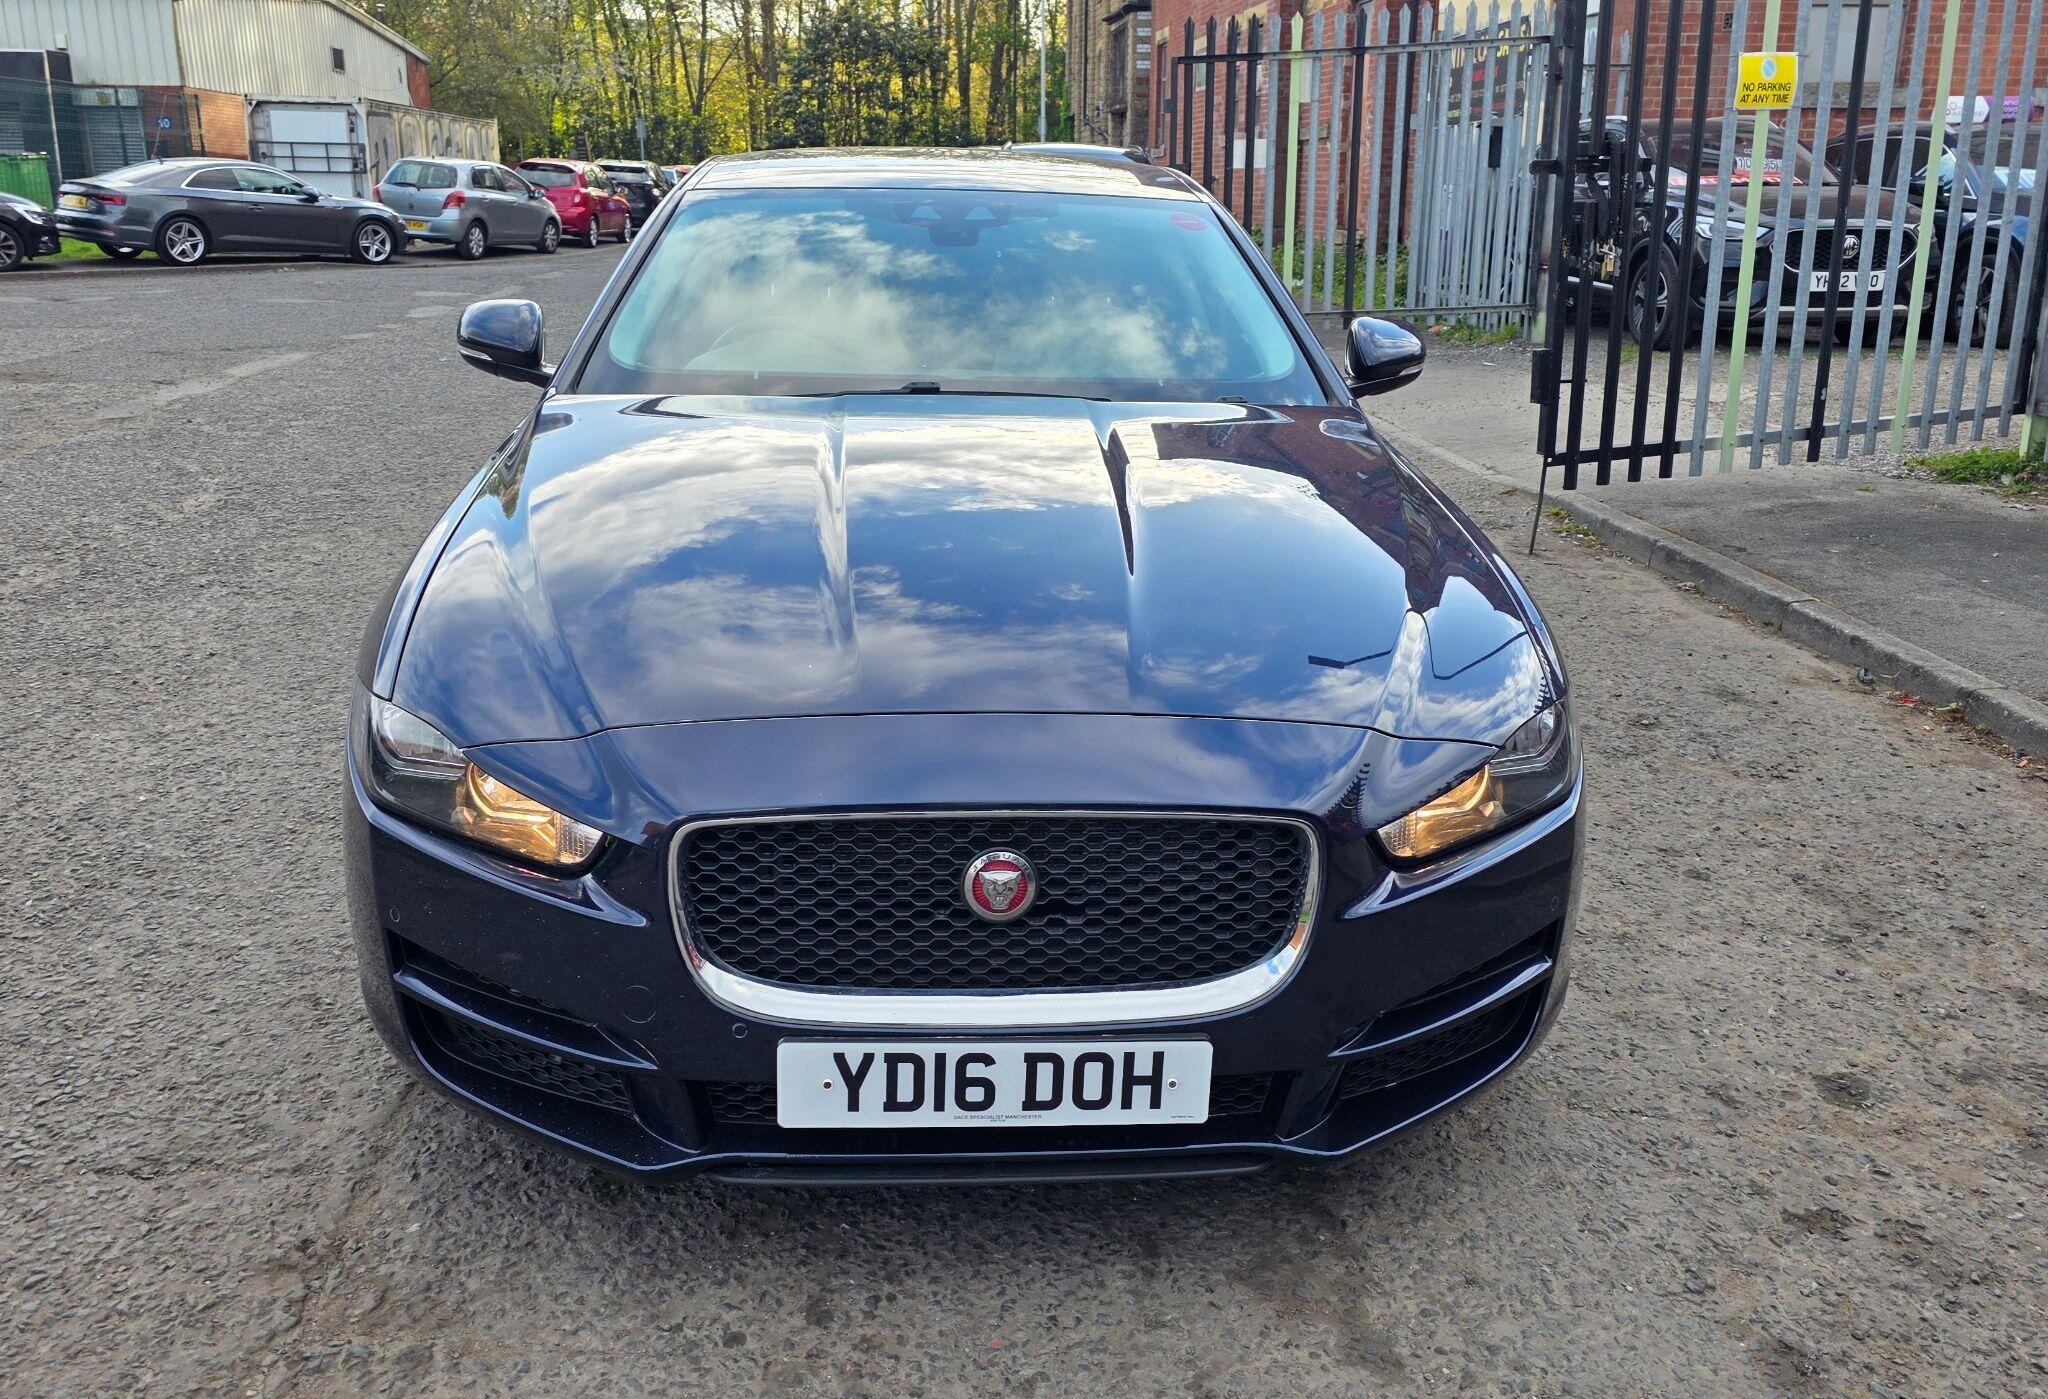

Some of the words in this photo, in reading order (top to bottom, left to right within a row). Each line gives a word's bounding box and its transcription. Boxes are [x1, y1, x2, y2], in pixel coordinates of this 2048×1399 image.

[1742, 83, 1755, 92] NO
[1757, 83, 1791, 92] PARKING
[1740, 94, 1751, 103] AT
[1752, 94, 1770, 103] ANY
[1772, 94, 1790, 103] TIME
[832, 1051, 996, 1112] YD16
[1021, 1050, 1165, 1111] DOH
